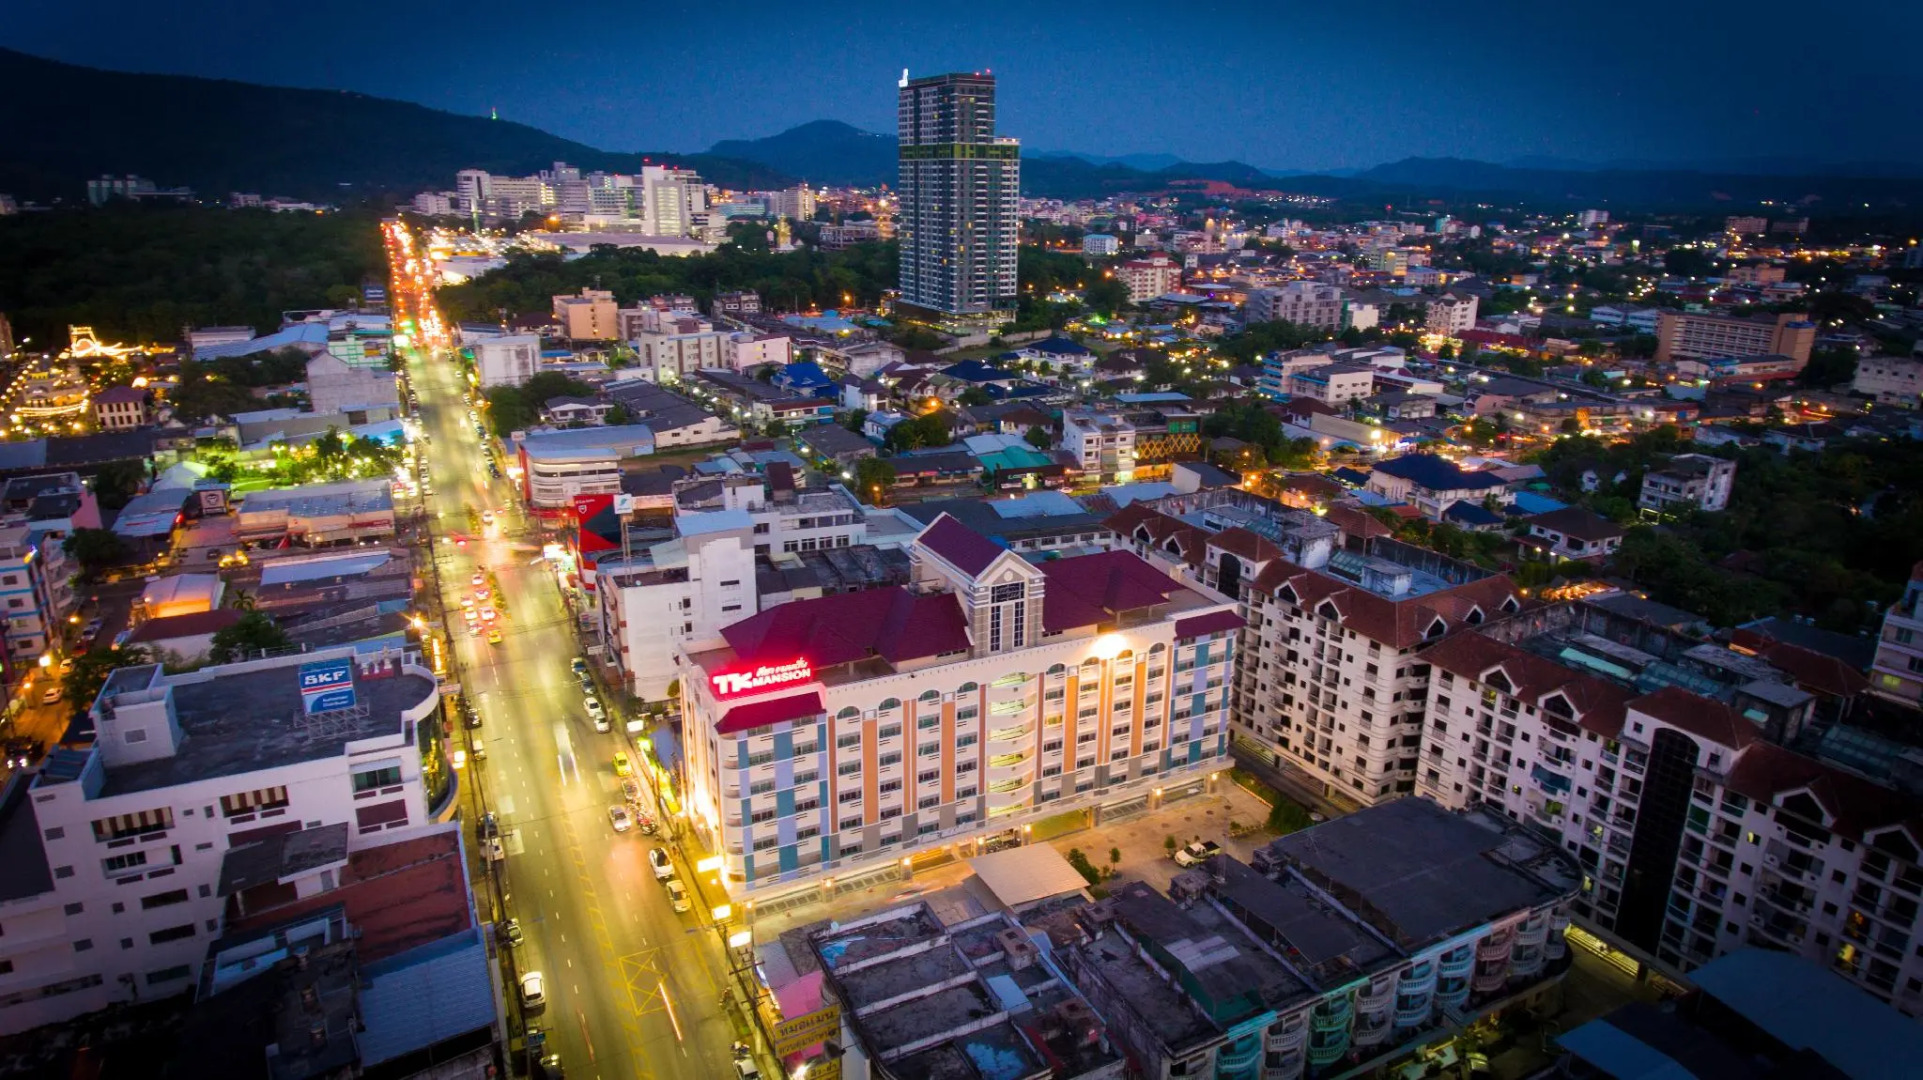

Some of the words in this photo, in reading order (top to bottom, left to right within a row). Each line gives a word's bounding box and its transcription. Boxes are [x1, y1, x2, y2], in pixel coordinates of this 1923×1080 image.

[304, 670, 346, 685] SKF
[713, 671, 753, 694] TK
[753, 668, 811, 687] MANSION
